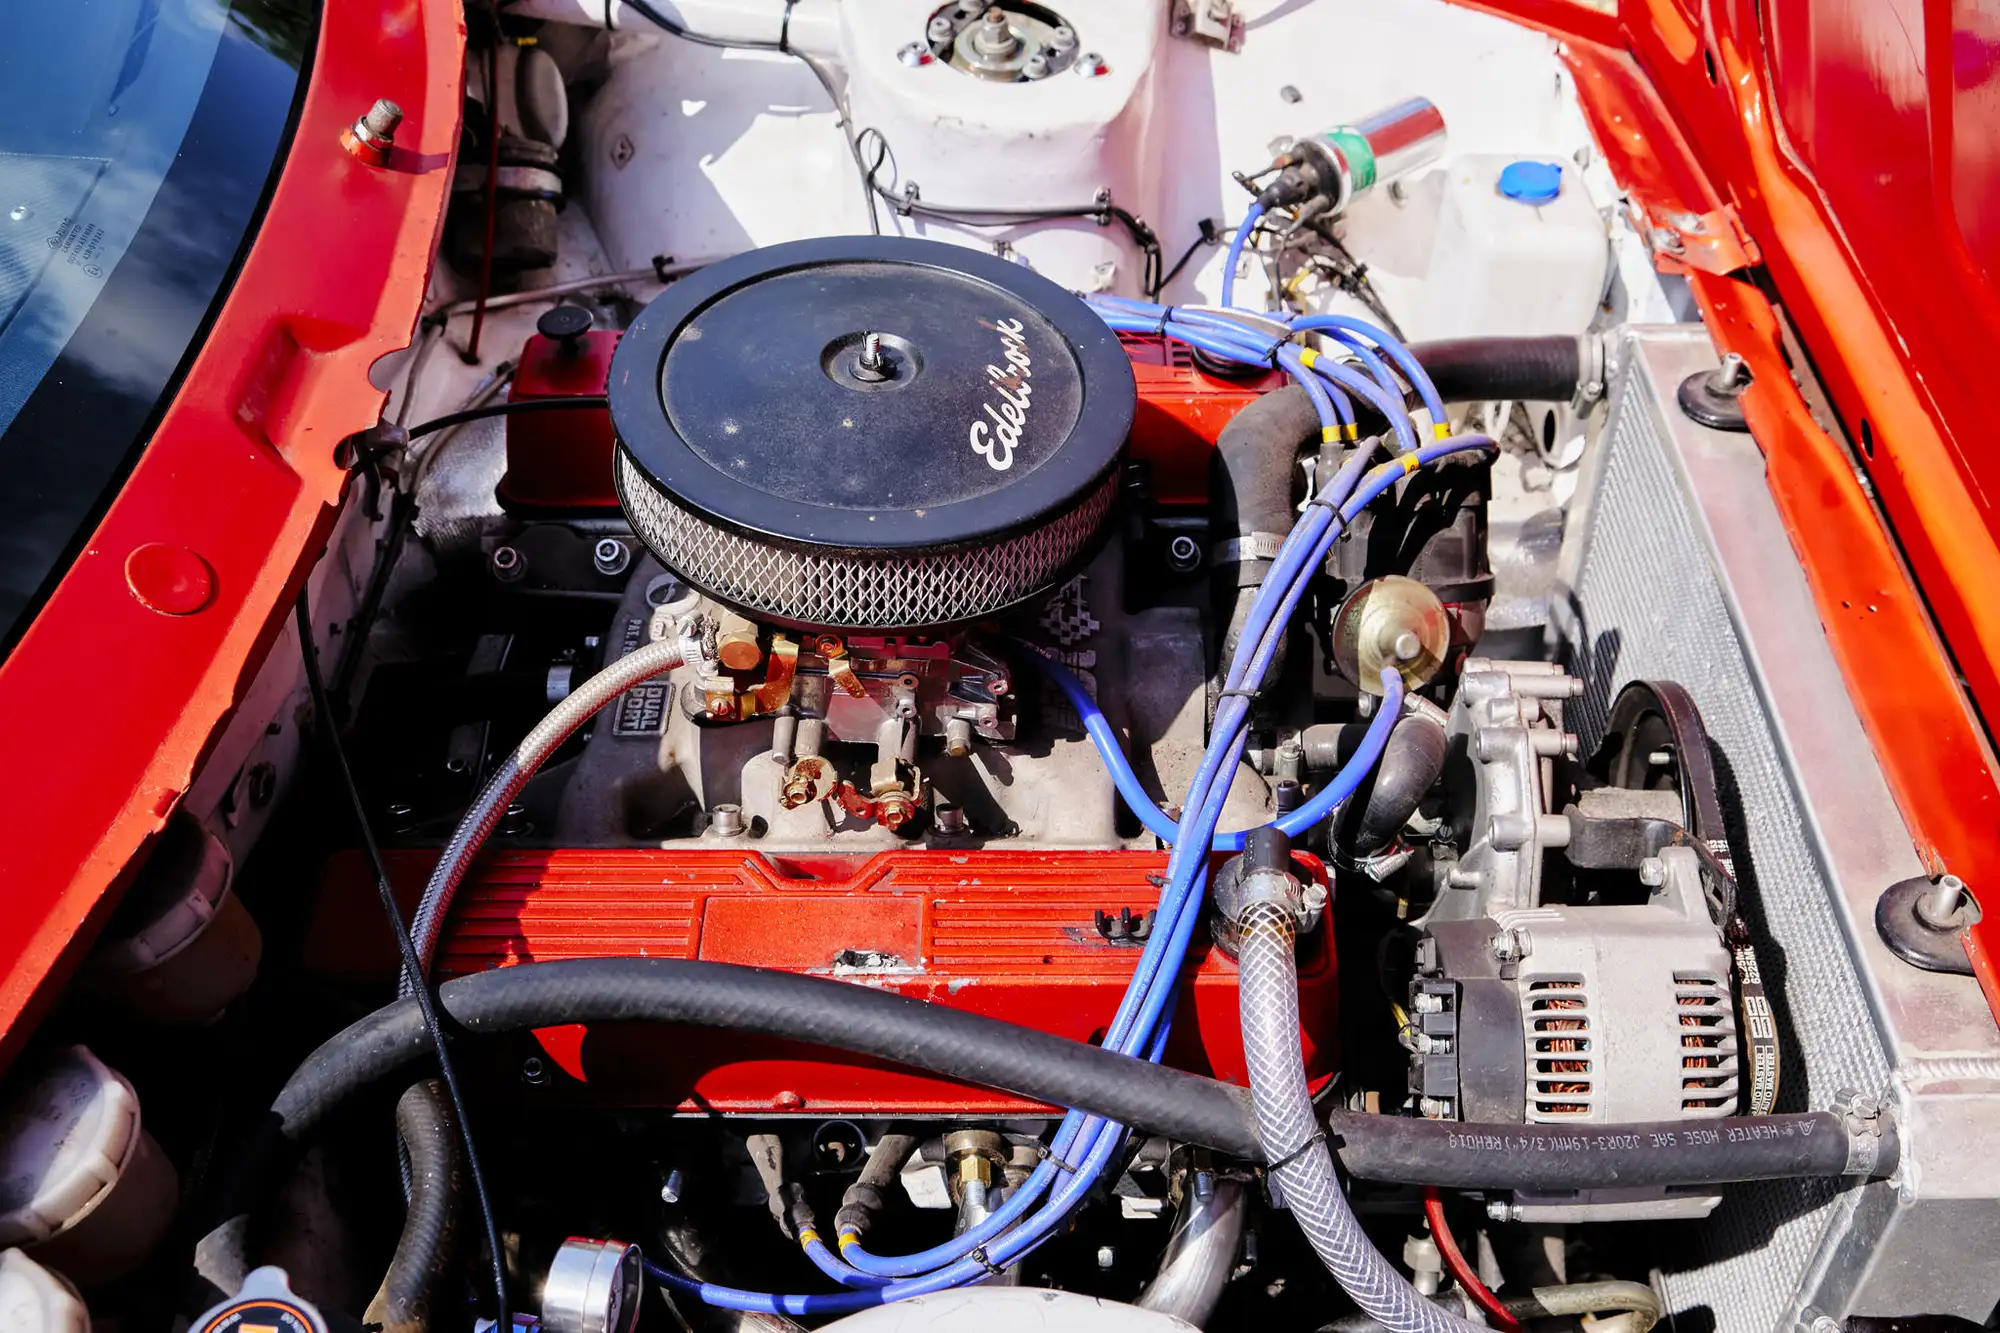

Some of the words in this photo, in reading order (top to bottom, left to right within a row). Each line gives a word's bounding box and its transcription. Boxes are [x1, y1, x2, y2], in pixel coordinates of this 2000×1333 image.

[970, 318, 1032, 471] Edelbrock
[622, 687, 646, 730] PORT
[640, 687, 663, 730] DUAL
[1732, 943, 1751, 985] 6225MC
[1743, 943, 1762, 985] 6225MC
[1755, 1053, 1765, 1090] MASTER
[1765, 1053, 1775, 1090] MASTER
[1649, 1132, 1677, 1148] SAE
[1683, 1129, 1720, 1145] HOSE
[1726, 1124, 1780, 1142] HEATER
